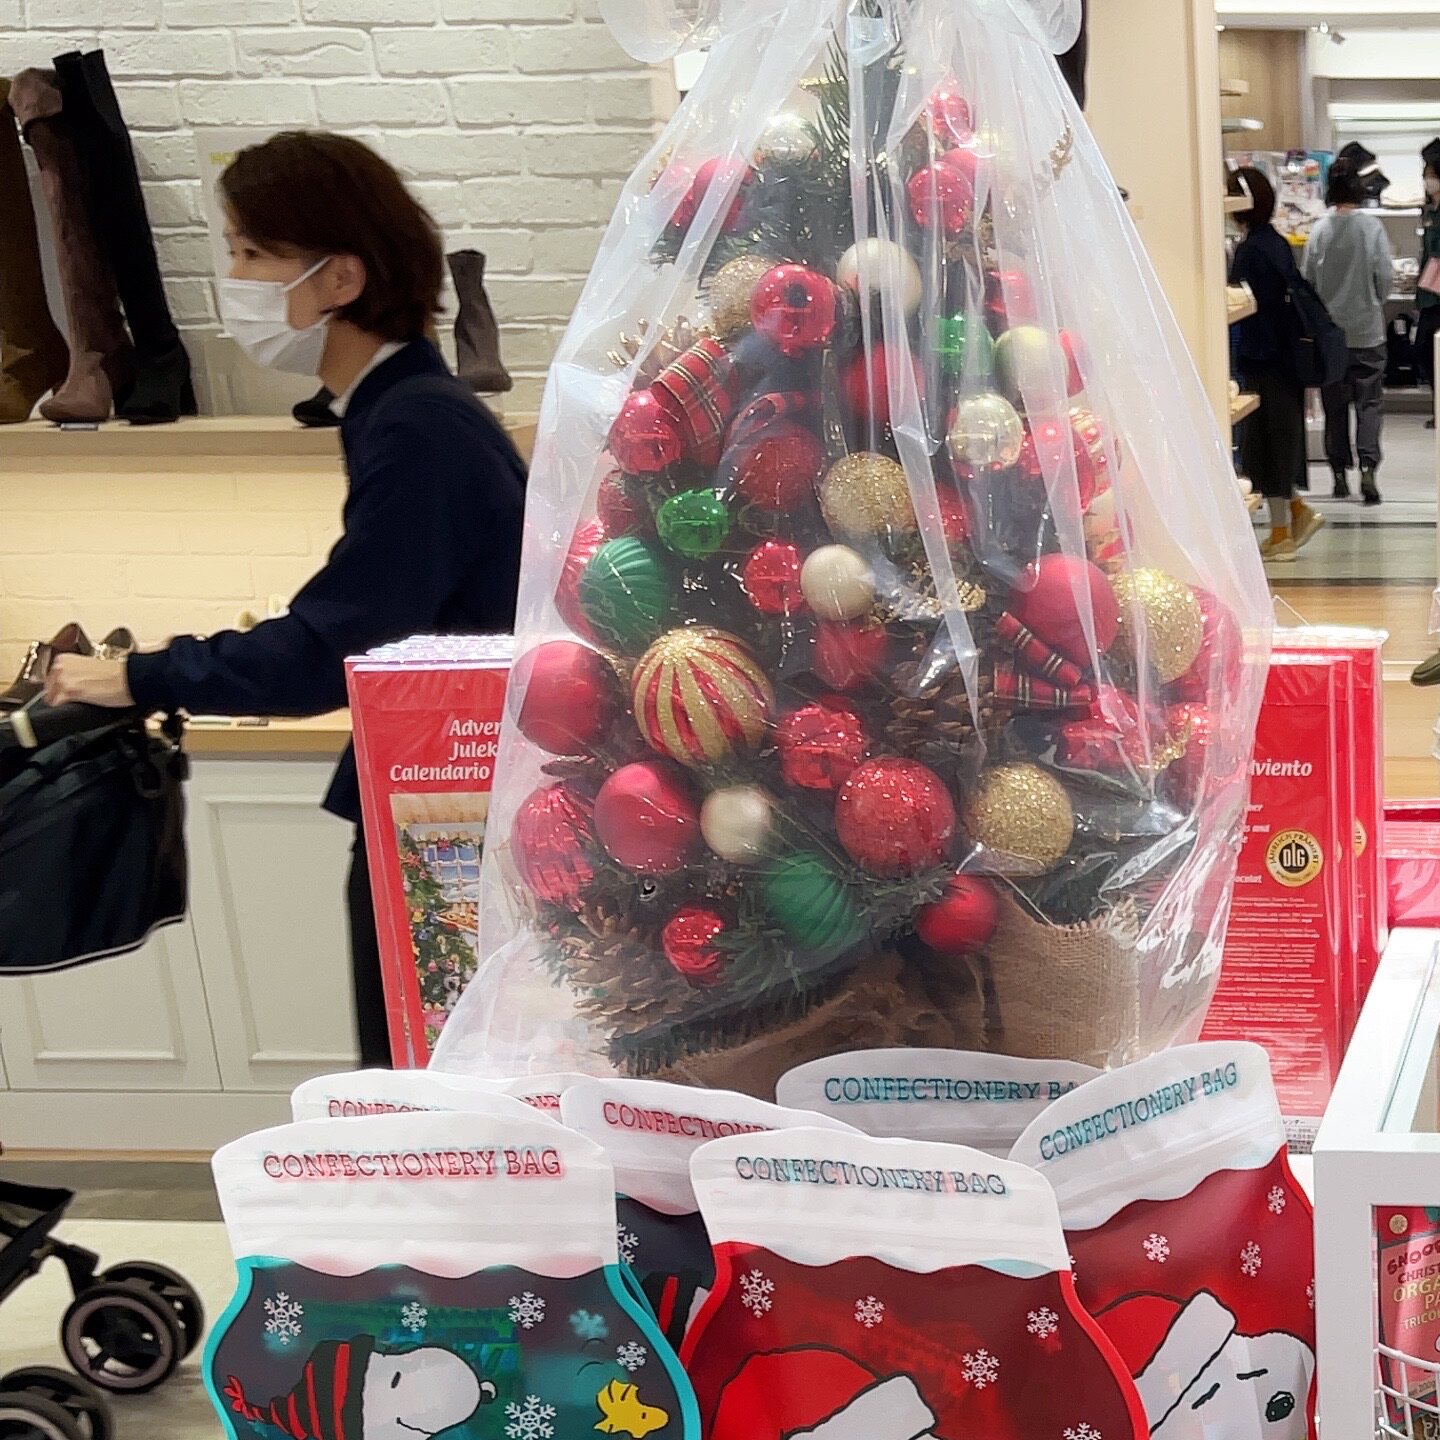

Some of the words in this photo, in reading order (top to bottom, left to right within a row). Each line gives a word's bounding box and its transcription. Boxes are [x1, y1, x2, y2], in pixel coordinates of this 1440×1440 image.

[390, 762, 490, 781] Calendario
[824, 1077, 1041, 1102] CONFECTIONERY
[1039, 1077, 1198, 1161] CONFECTIONERY
[1201, 1062, 1239, 1096] BAG
[262, 1149, 495, 1181] CONFECTIONERY
[505, 1149, 562, 1177] BAG
[734, 1155, 947, 1194] CONFECTIONERY
[955, 1173, 1008, 1196] BAG
